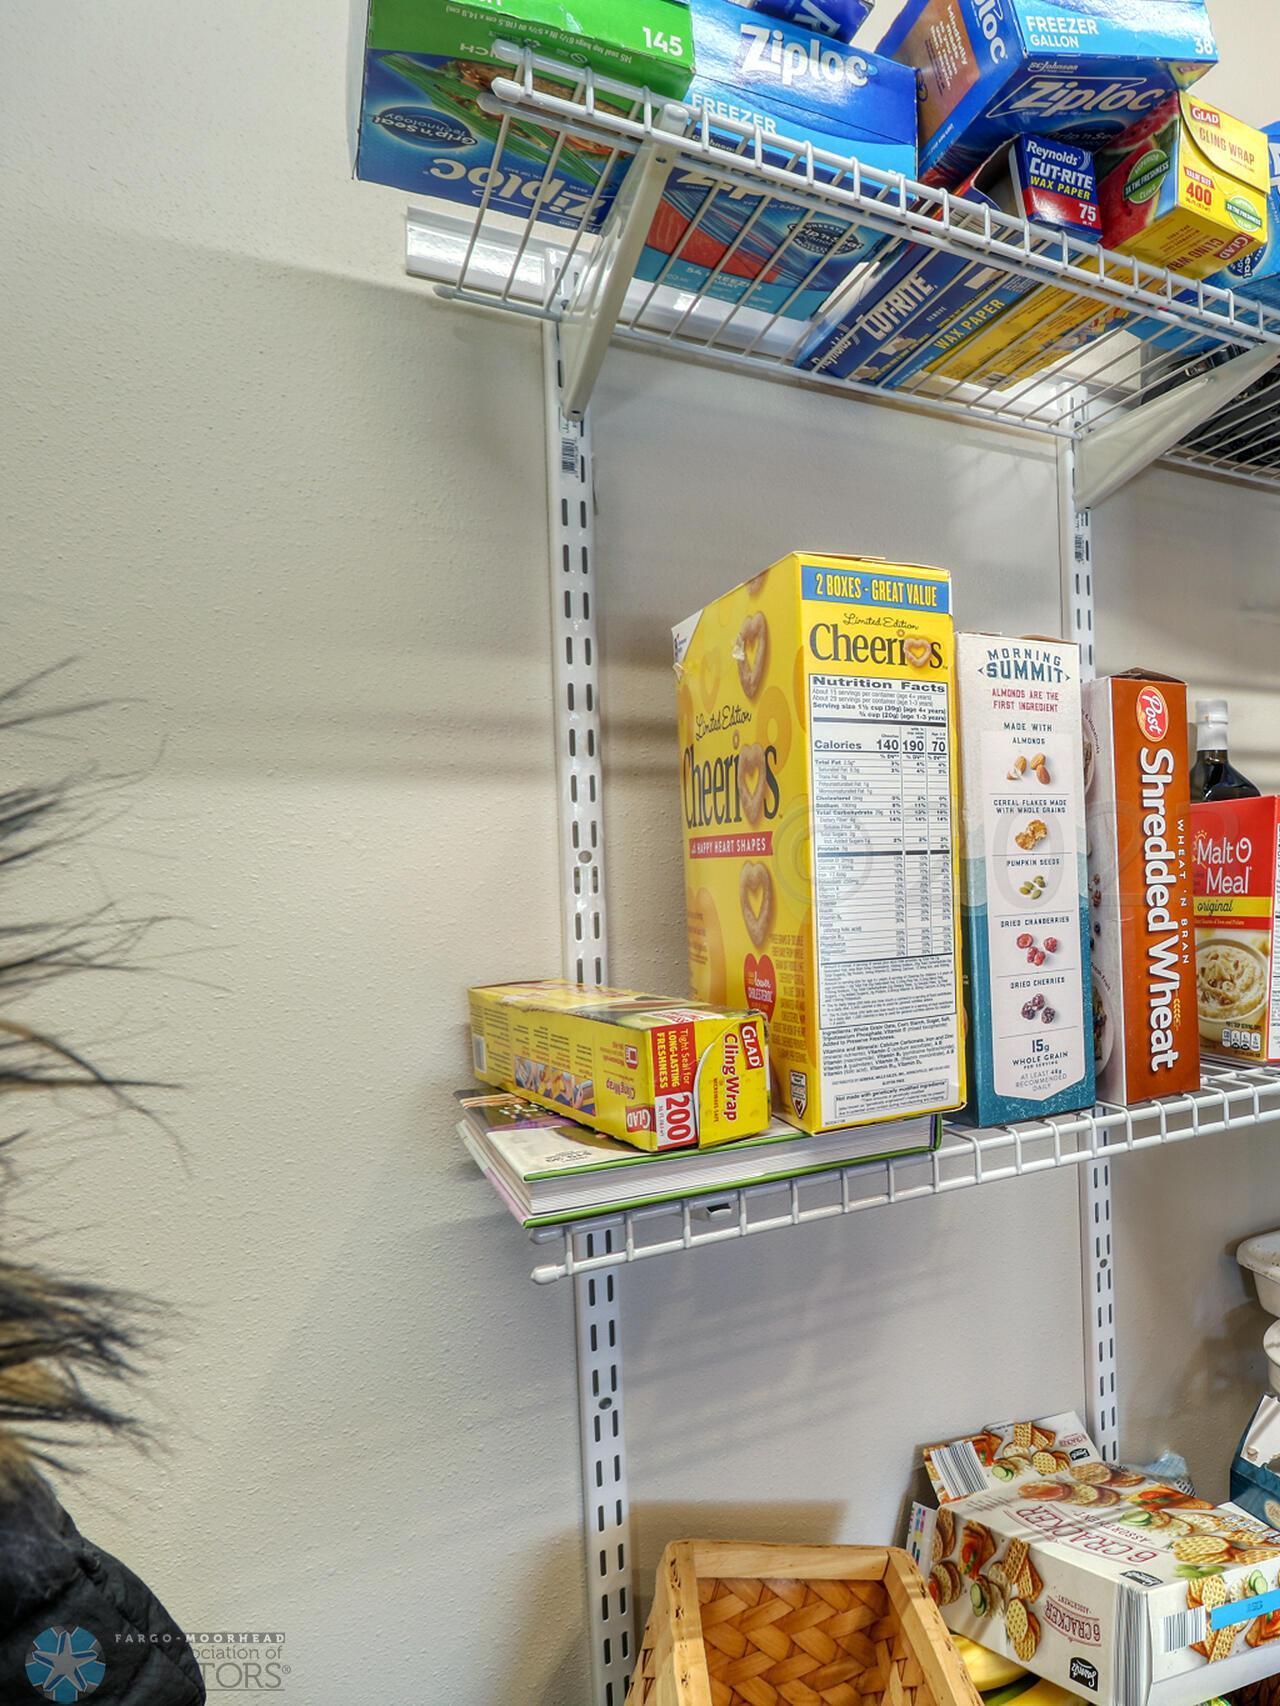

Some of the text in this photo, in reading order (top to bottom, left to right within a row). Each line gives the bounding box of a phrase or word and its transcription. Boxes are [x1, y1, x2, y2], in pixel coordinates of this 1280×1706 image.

[1026, 15, 1099, 36] FREEZER
[642, 26, 683, 57] 145
[1030, 33, 1079, 49] GALLON
[1194, 37, 1213, 55] 38
[740, 23, 869, 87] Ziploc
[1009, 79, 1166, 118] Ziploc
[692, 93, 777, 134] FREEZER
[1191, 106, 1220, 125] GLAD
[1199, 127, 1255, 165] CLING WRAP
[1144, 160, 1169, 185] FRESHNESS
[1184, 167, 1200, 181] VALUE
[429, 157, 607, 223] Ziploc
[1029, 176, 1091, 201] WAX PAPER
[1186, 182, 1212, 206] 400
[1078, 203, 1097, 222] 75
[1219, 235, 1249, 260] GLAD
[935, 298, 1005, 350] WAX PAPER
[815, 573, 937, 607] 2 BOXES GREAT VALUE
[843, 612, 919, 631] Limited Edition
[988, 647, 1062, 667] MORNING
[986, 661, 1064, 683] SUMMIT
[813, 676, 945, 693] Nutrition Facts
[992, 687, 1060, 701] ALMONDS ARE THE
[813, 702, 840, 710] Serving
[842, 703, 856, 711] size
[993, 700, 1058, 713] FIRST INGREDIENT
[1141, 693, 1163, 737] Post
[695, 704, 752, 742] Limited Edition
[1003, 722, 1052, 732] MADE WITH
[814, 739, 946, 753] Calories 140 190 70
[1012, 736, 1045, 745] ALMONDS
[993, 799, 1020, 807] CEREAL
[1022, 799, 1047, 807] FLAKES
[996, 805, 1066, 814] WITH WHOLE GRAINS
[714, 837, 735, 853] HEART
[737, 836, 767, 852] SHAPES
[1176, 818, 1187, 880] WHEAT
[1197, 837, 1252, 866] Malt O
[1006, 858, 1060, 867] PUMPKIN SEEDS
[1206, 866, 1250, 895] Meal
[1140, 747, 1180, 1073] Shredded Wheat
[1197, 900, 1233, 916] original
[1000, 915, 1070, 928] DRIED CRANBERRIES
[1180, 918, 1190, 965] BRAN
[1010, 976, 1065, 990] DRIED CHERRIES
[680, 1029, 690, 1047] Tight
[741, 1025, 763, 1069] GLAD
[1031, 1039, 1050, 1053] 15g
[656, 1032, 668, 1089] FRESHNESS
[669, 1030, 678, 1088] LONG-LASTING
[681, 1048, 690, 1069] Seal
[1012, 1051, 1069, 1067] WHOLE GRAIN
[721, 1033, 741, 1123] Cling Wrap
[1015, 1073, 1068, 1088] RECOMMENDED
[626, 1107, 650, 1131] GLAD
[665, 1094, 690, 1147] 200
[1016, 1505, 1158, 1563] 6 CRACKER
[1045, 1600, 1100, 1641] 6 CRACKER
